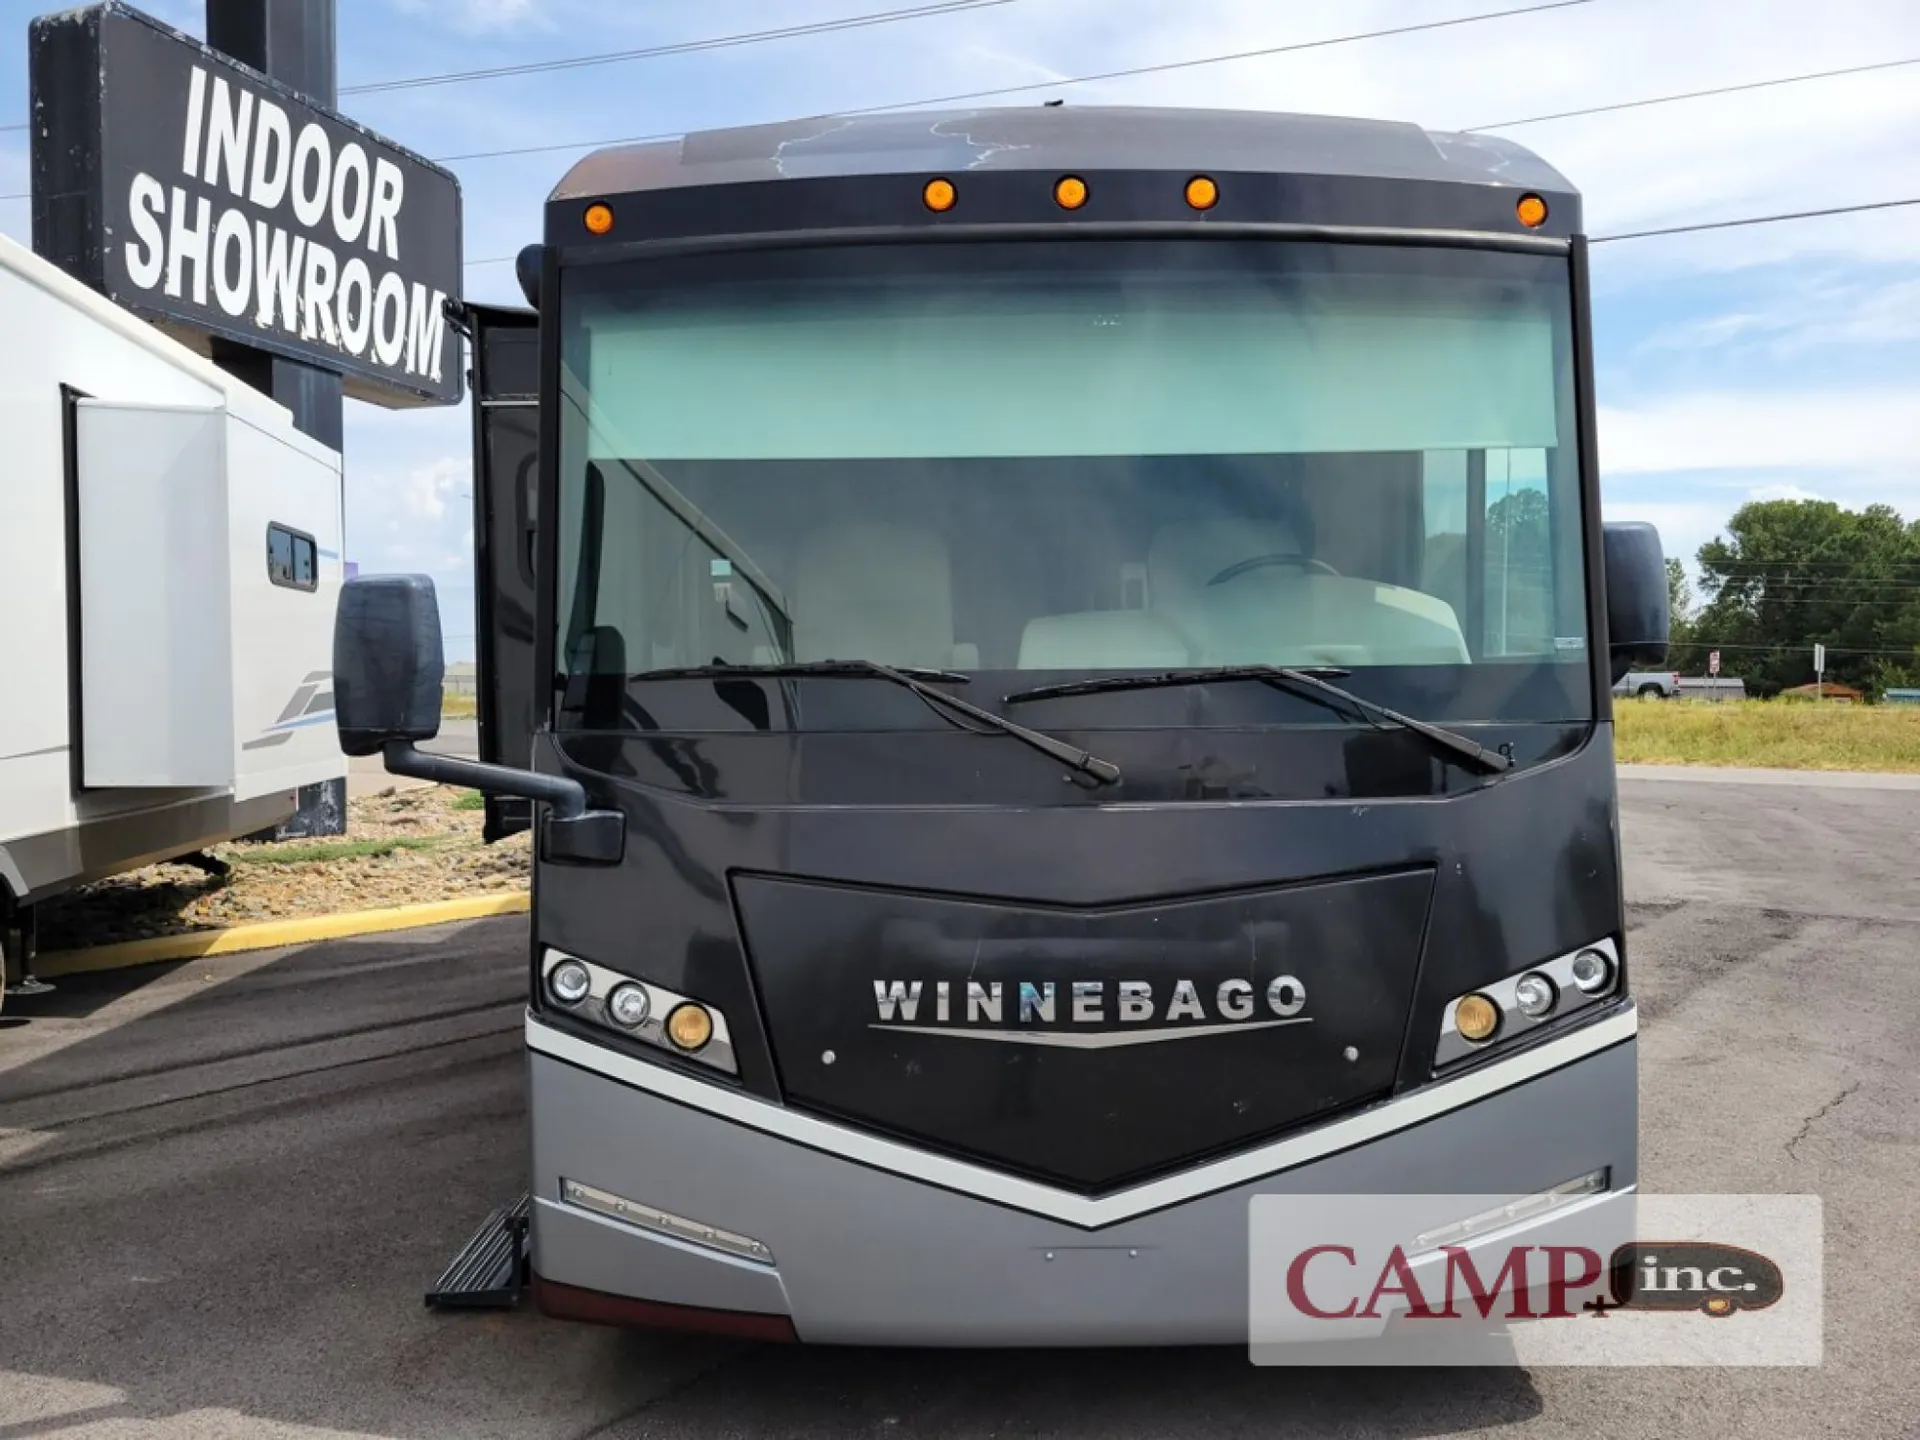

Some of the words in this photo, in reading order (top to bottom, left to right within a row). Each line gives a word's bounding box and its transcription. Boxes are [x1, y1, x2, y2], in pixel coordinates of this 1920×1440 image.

[182, 66, 403, 260] INDOOR
[125, 172, 447, 383] SHOWROOM
[873, 975, 1307, 1022] WINNEBAGO
